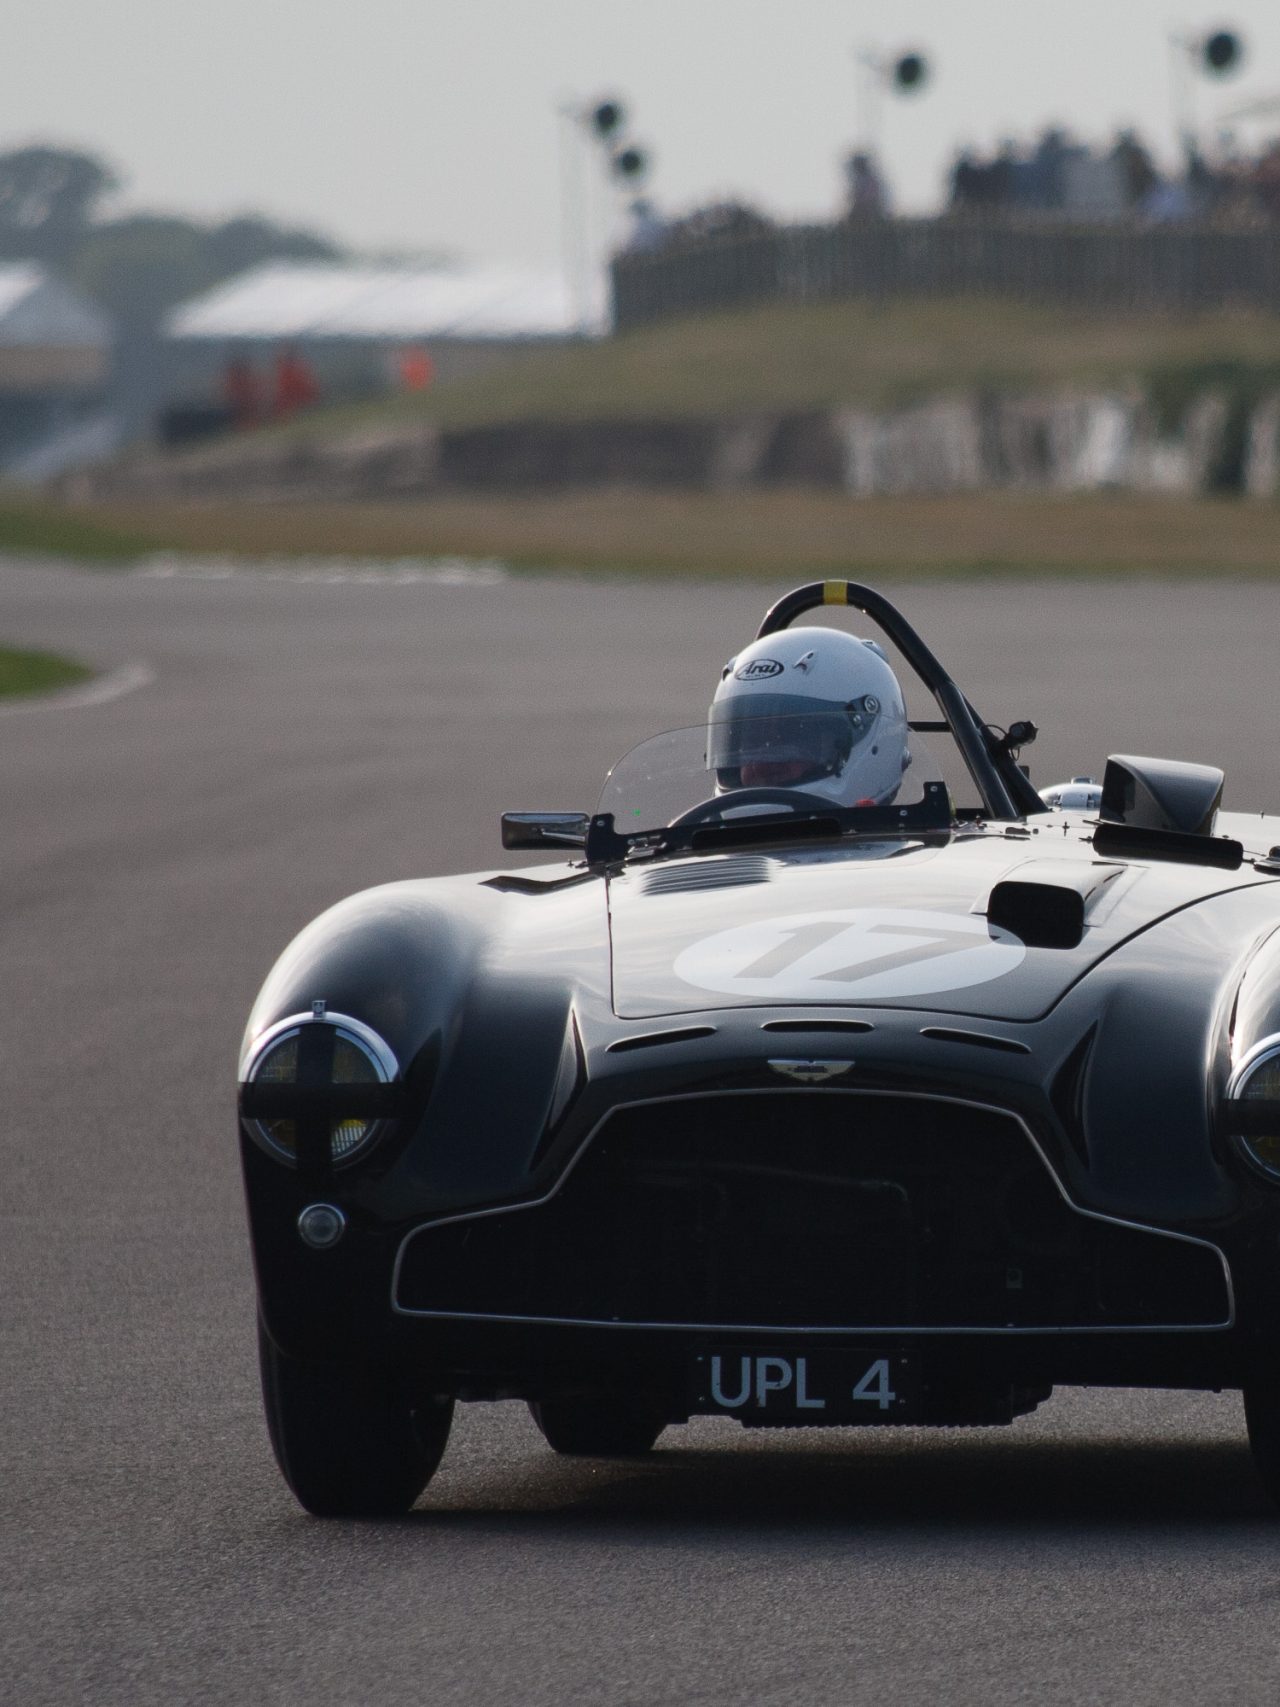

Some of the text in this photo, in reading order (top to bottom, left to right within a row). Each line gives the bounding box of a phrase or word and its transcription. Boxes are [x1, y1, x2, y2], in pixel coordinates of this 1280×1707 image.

[739, 660, 778, 676] Arai
[733, 921, 998, 983] 17
[711, 1356, 896, 1410] UPL 4
